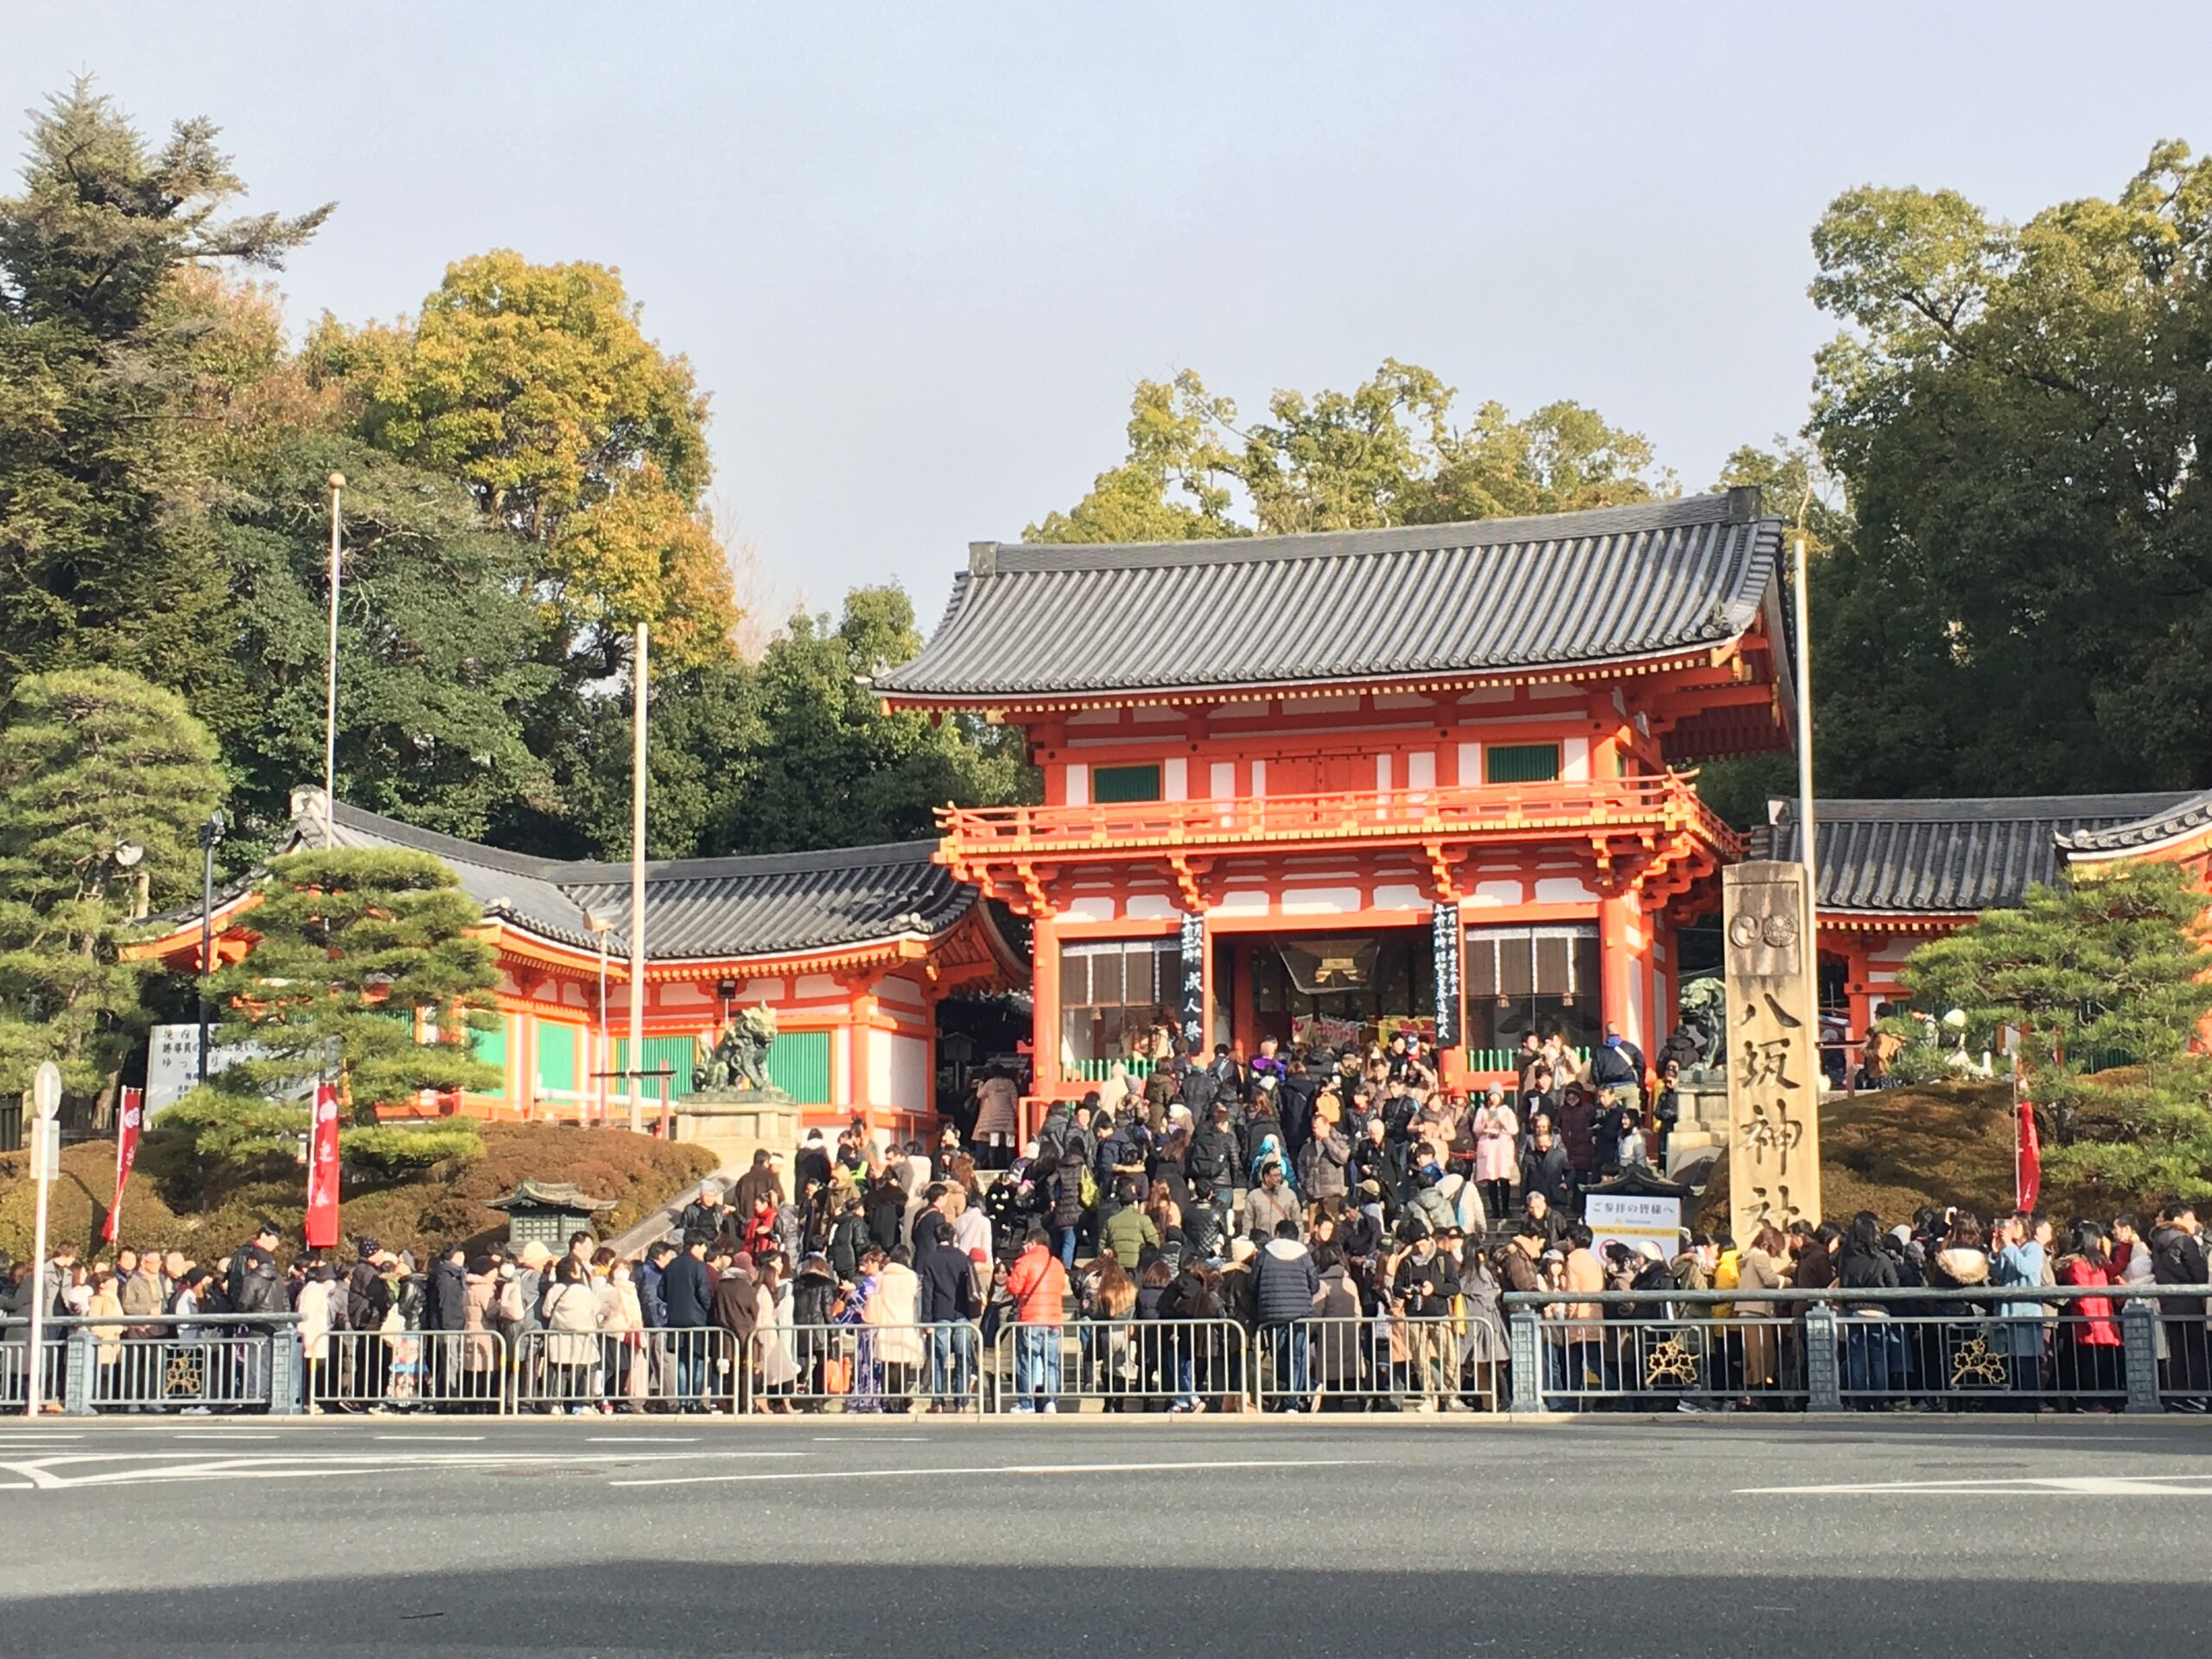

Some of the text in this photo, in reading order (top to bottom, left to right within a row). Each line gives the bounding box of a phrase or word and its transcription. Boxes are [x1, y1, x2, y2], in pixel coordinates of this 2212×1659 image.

[1184, 972, 1204, 1042] 成人祭
[1732, 993, 1802, 1234] 八坂神社
[1592, 1202, 1675, 1214] ご参拝の皆様へ
